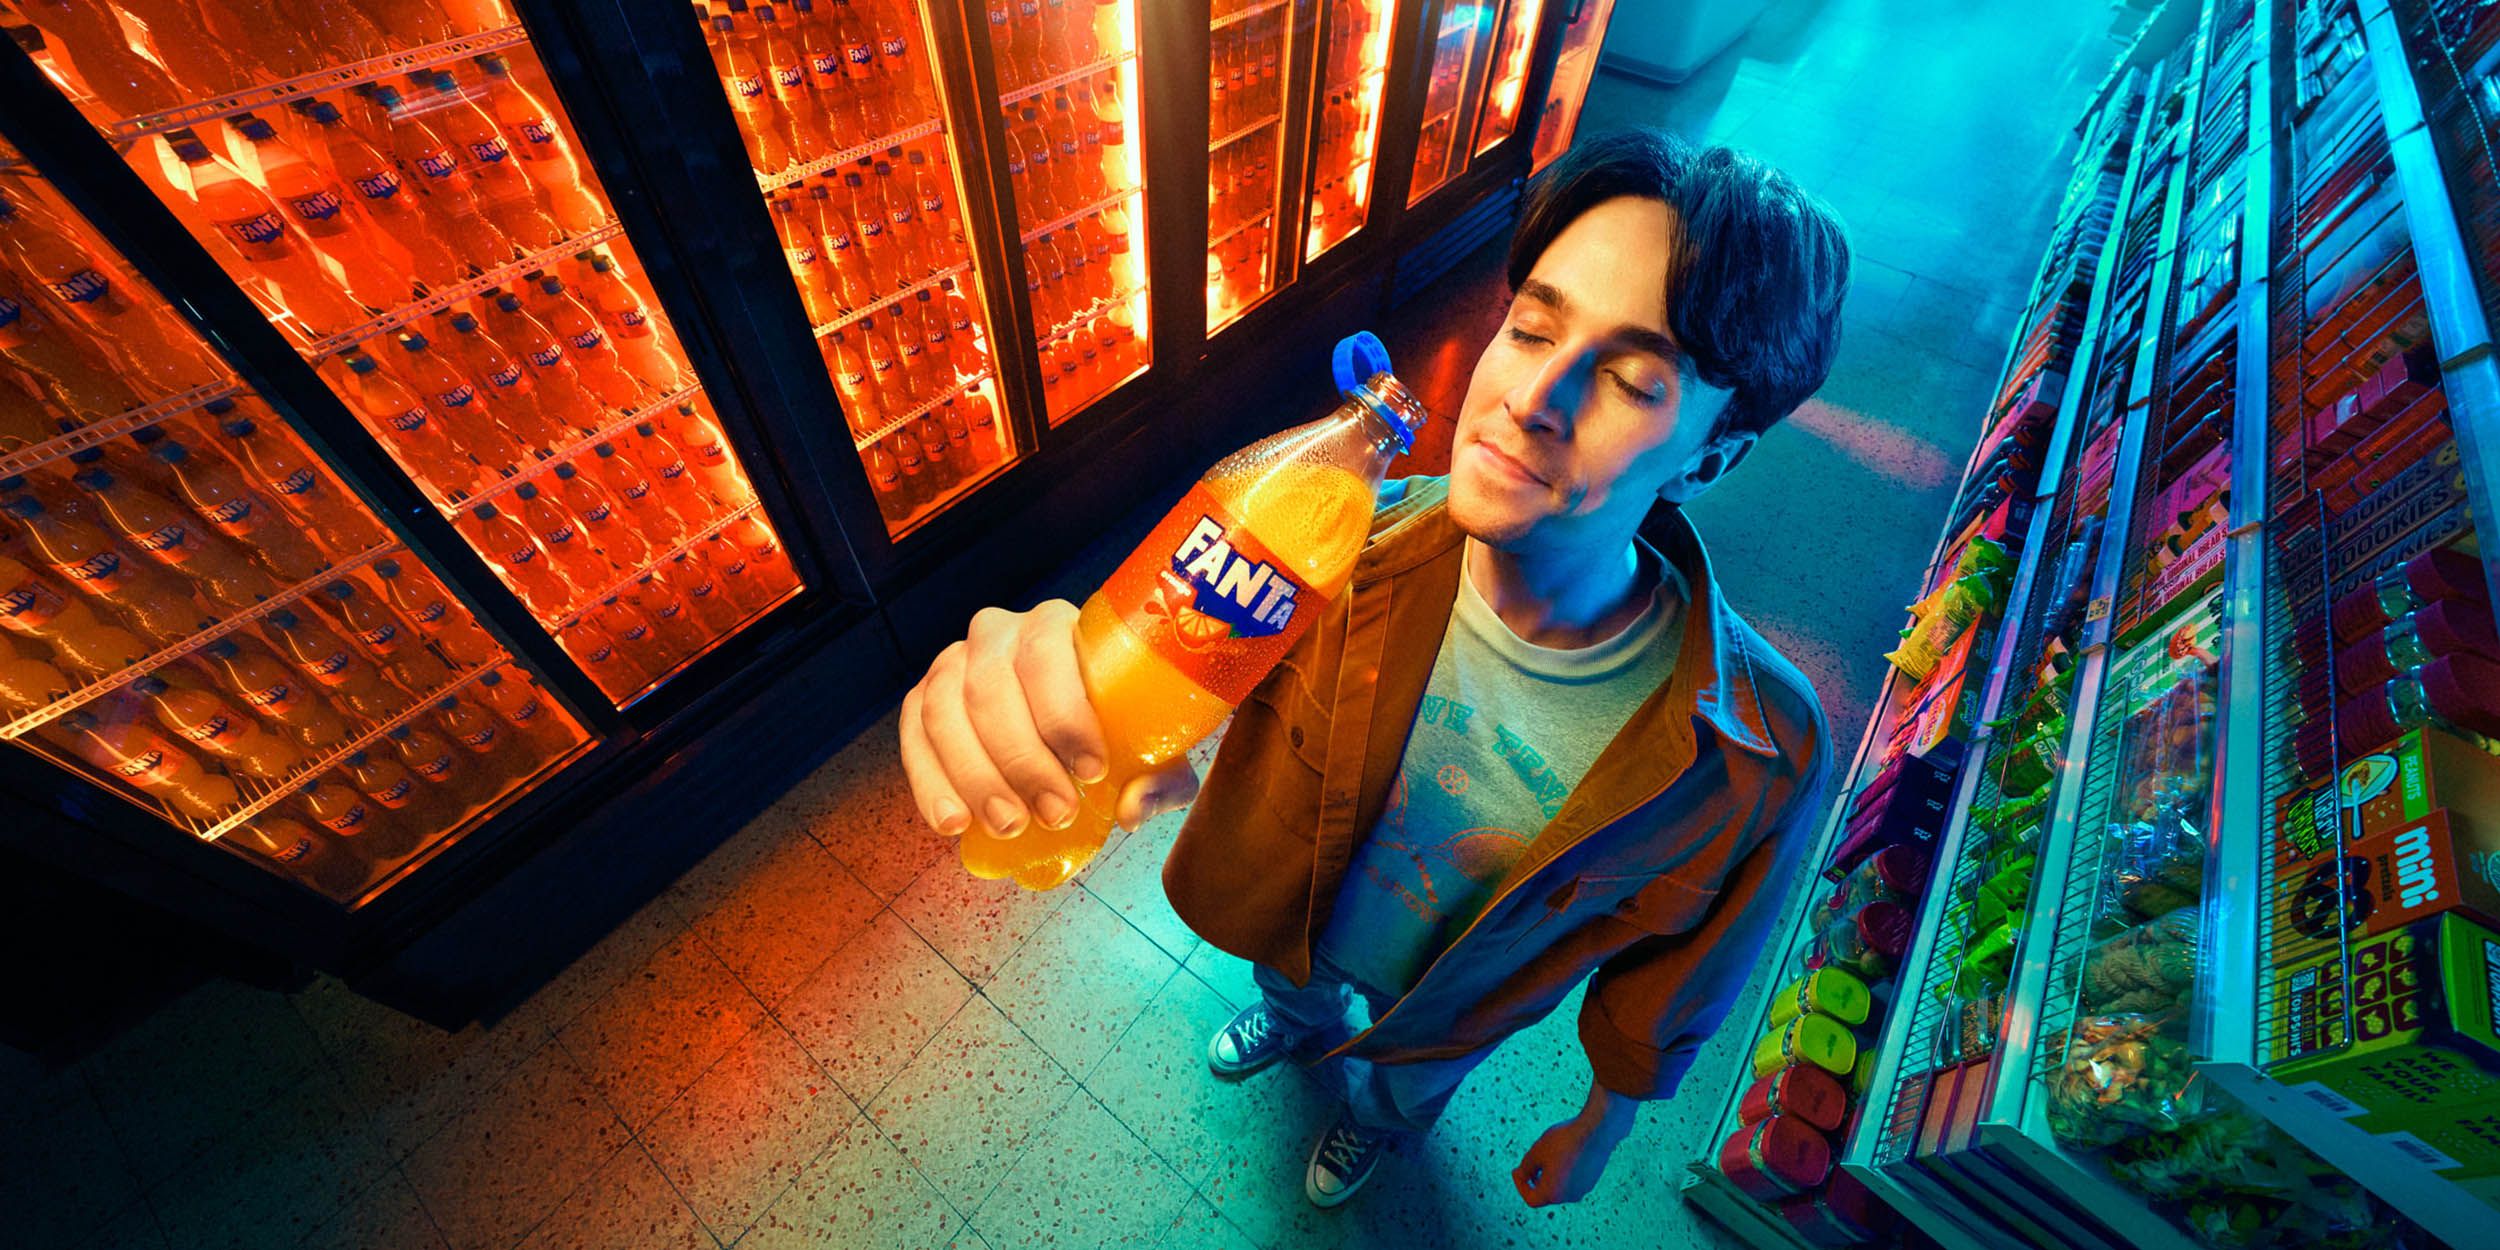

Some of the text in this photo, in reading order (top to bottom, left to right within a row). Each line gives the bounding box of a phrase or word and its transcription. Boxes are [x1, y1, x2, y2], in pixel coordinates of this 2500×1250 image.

[882, 37, 906, 56] FANT
[735, 74, 763, 97] FANT
[777, 64, 801, 86] FANT
[1174, 515, 1297, 631] FANTA
[2404, 755, 2422, 801] PEANUTS
[2394, 826, 2439, 909] mini
[2400, 1058, 2446, 1079] ARE
[2421, 1051, 2459, 1070] WE
[2360, 1066, 2434, 1103] FAMILY
[2383, 1061, 2441, 1095] YOUR
